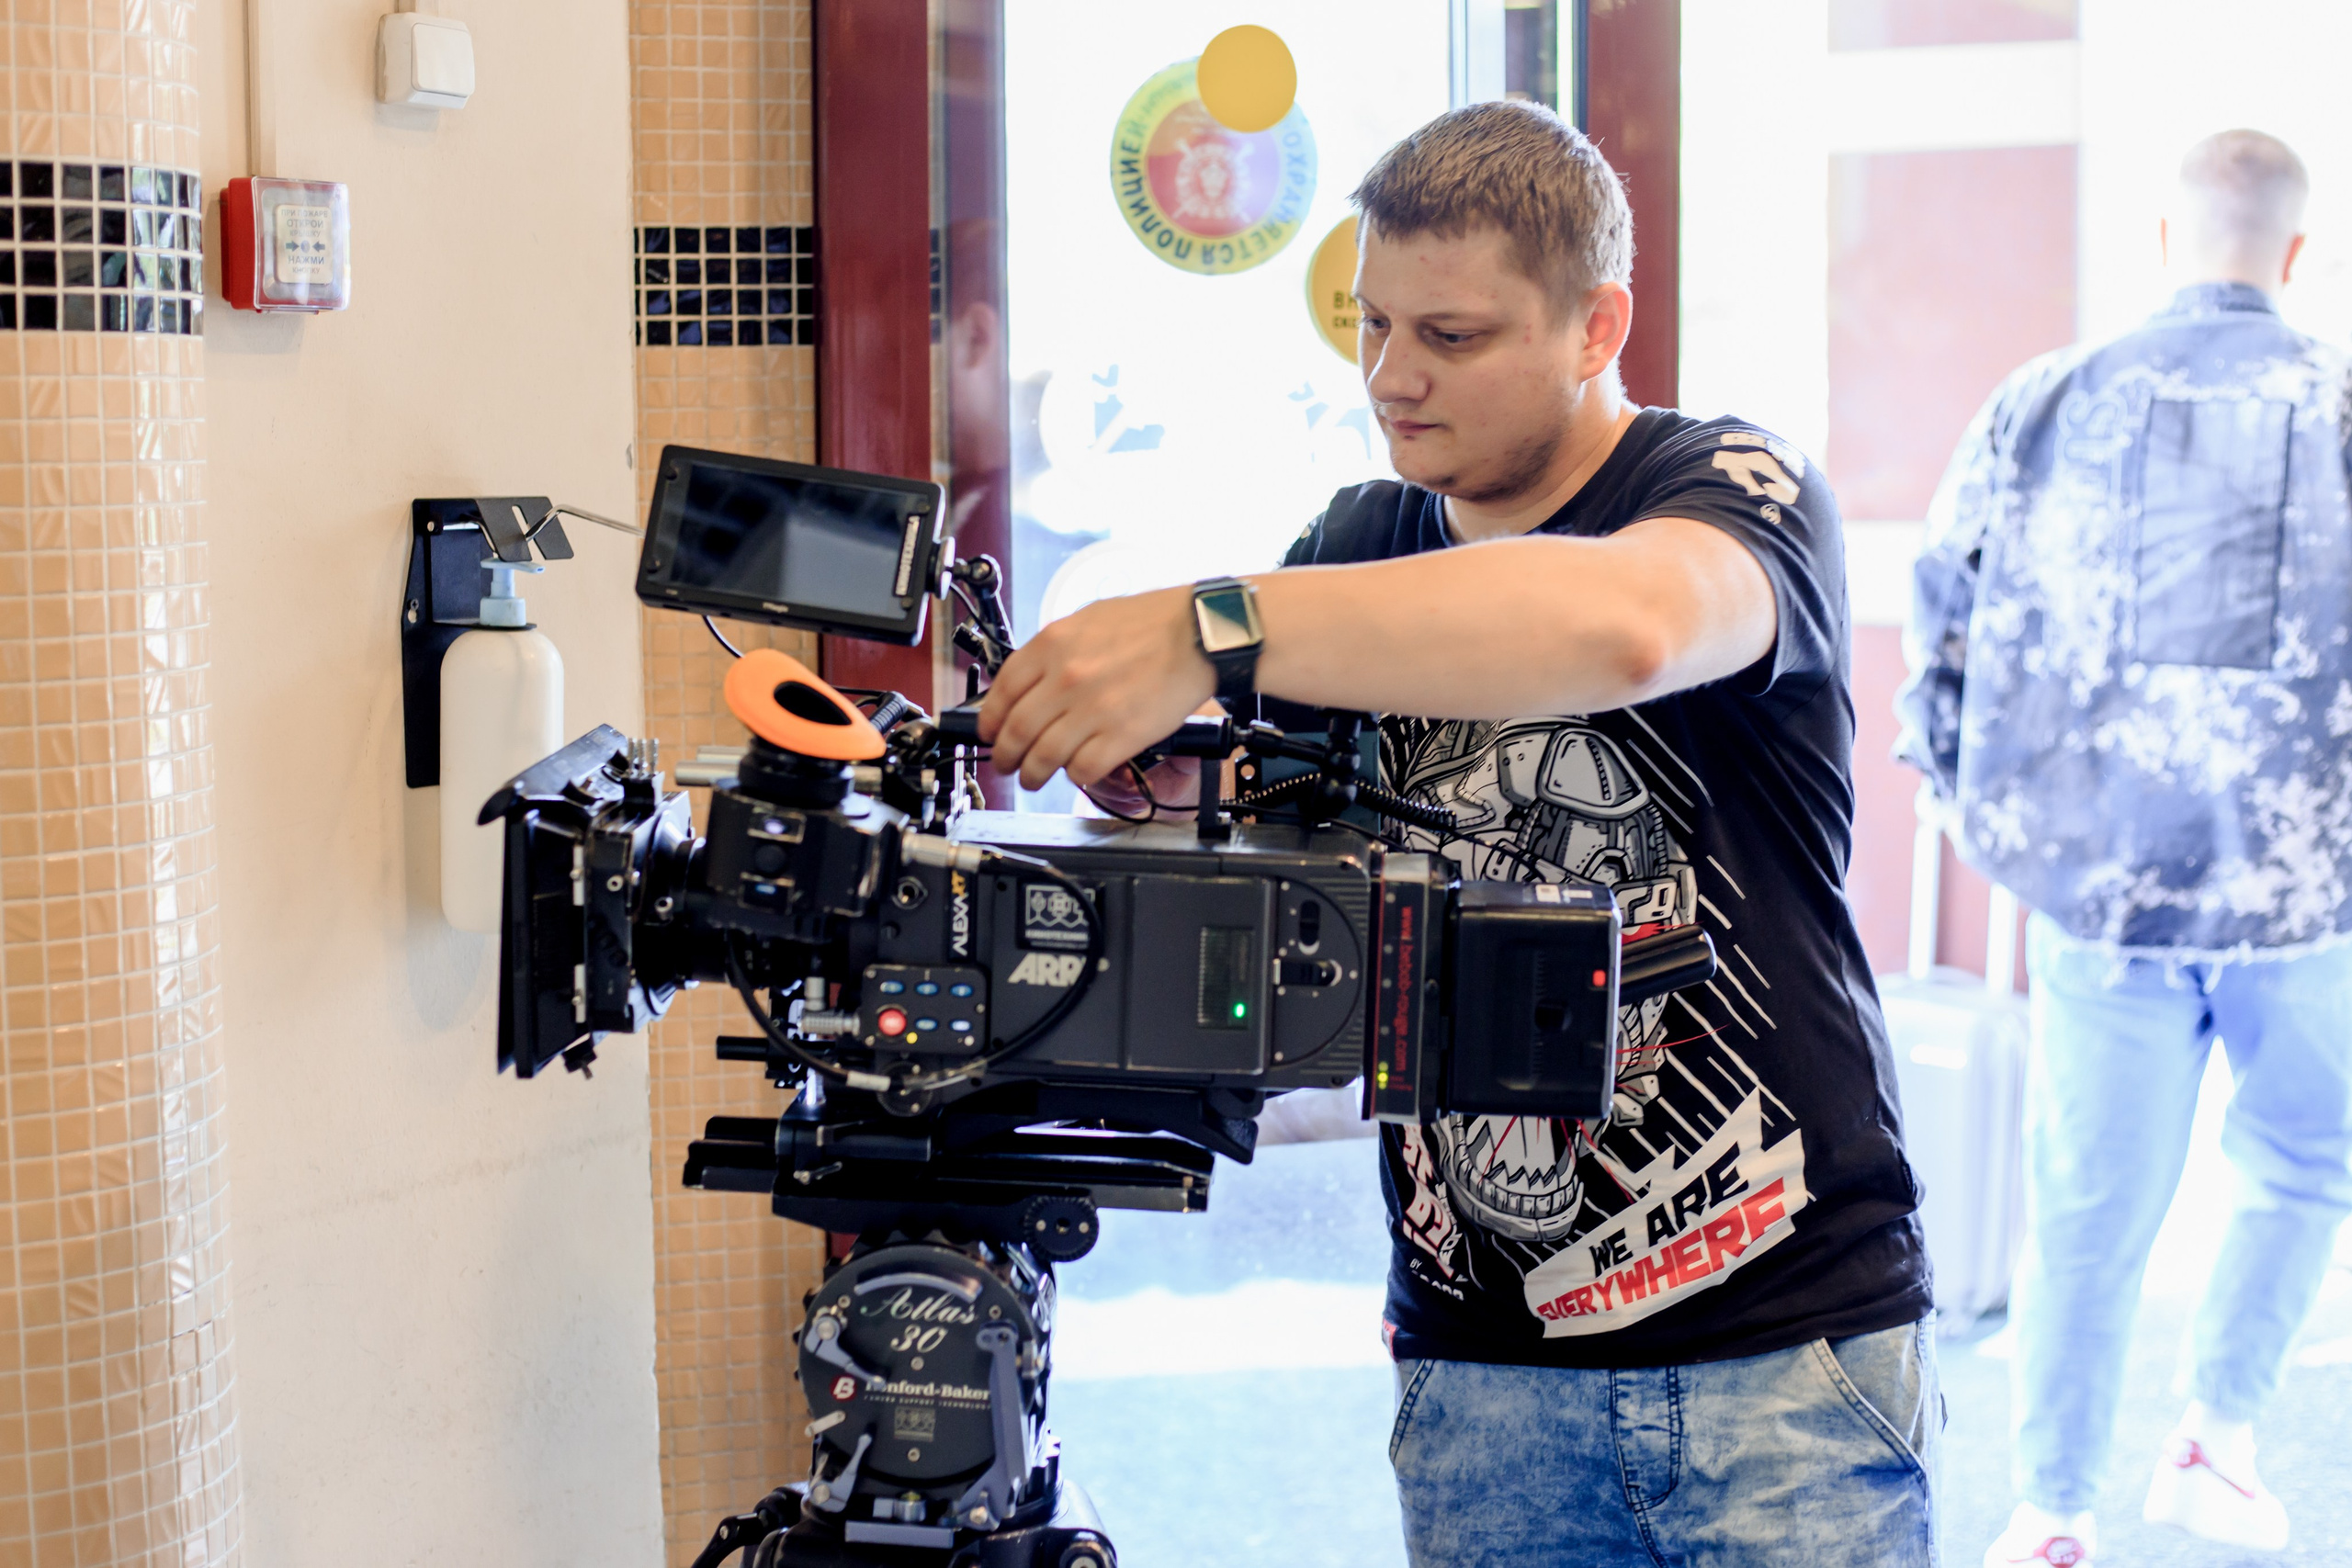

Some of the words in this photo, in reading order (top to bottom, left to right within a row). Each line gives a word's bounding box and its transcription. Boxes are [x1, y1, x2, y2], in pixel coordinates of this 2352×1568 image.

[1120, 119, 1193, 261] ПОЛИЦИЕЙ
[1202, 131, 1307, 265] ОХРАНЯЕТСЯ
[288, 255, 324, 265] НАЖМИ
[1007, 952, 1088, 987] ARR
[1536, 1177, 1786, 1321] EVERYWHERE
[1589, 1227, 1634, 1279] WE
[1646, 1141, 1750, 1248] ARE
[890, 1324, 948, 1353] 30
[865, 1380, 990, 1401] nford-Baker
